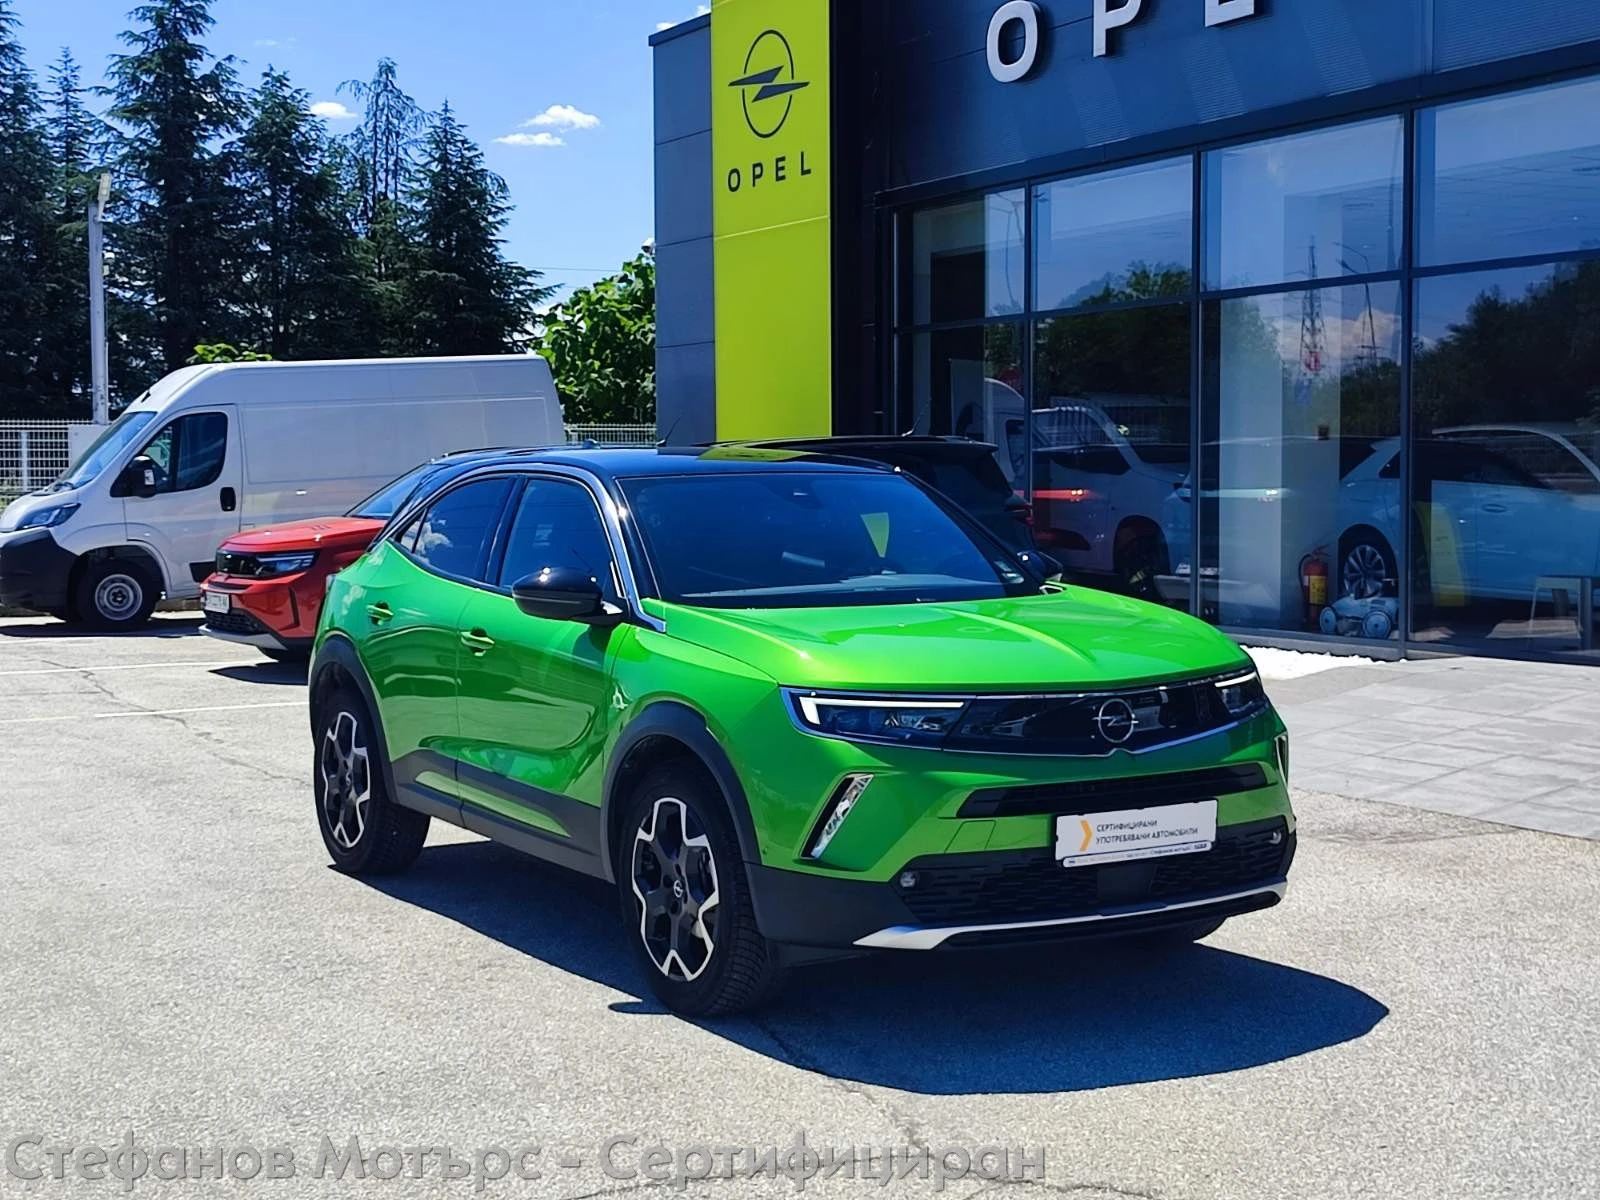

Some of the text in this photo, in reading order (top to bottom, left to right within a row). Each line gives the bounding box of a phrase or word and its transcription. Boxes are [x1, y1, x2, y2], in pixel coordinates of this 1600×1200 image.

[727, 151, 811, 192] OPEL
[1096, 819, 1158, 832] СЕРТИФИЦИРАНИ
[1096, 826, 1199, 845] УПОТРЕБЯВАНИ АВТОМОБИЛИ
